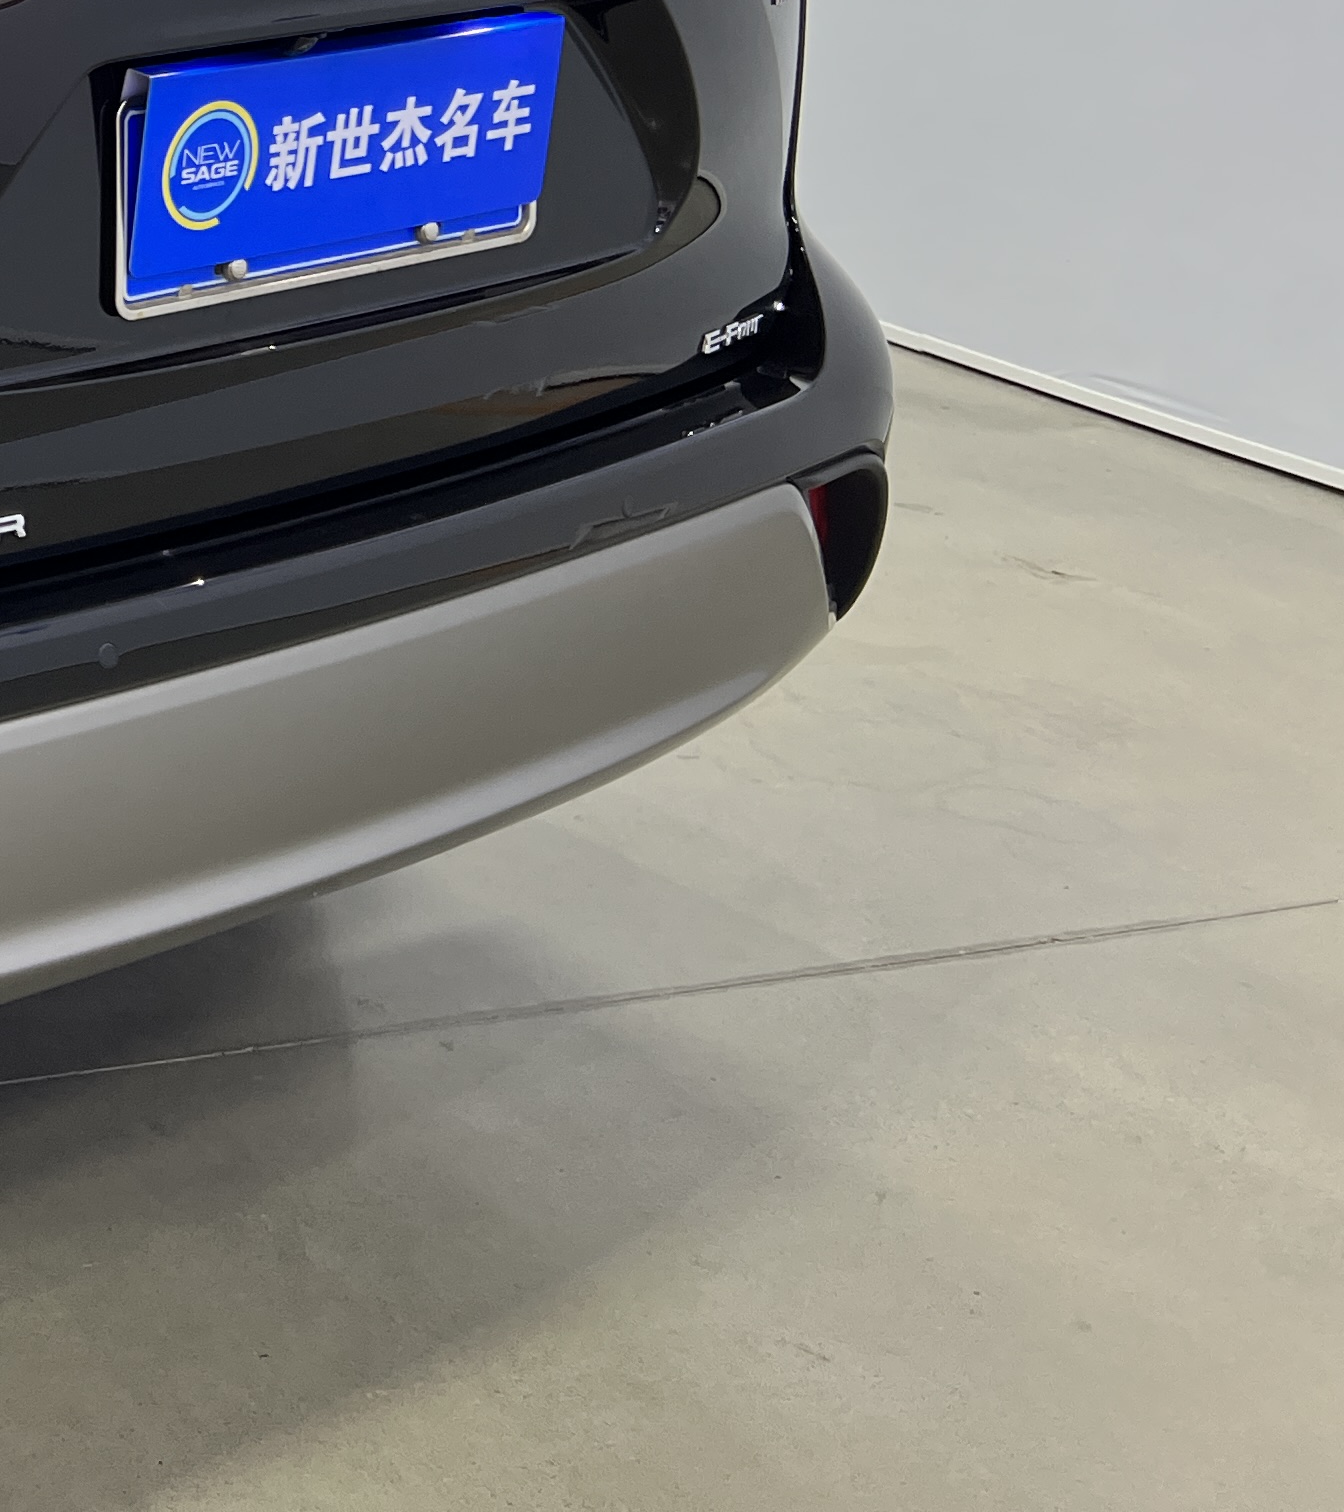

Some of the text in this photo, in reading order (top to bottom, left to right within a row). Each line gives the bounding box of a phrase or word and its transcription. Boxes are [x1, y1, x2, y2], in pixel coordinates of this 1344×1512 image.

[265, 79, 536, 192] 新世杰名车
[181, 139, 241, 169] NEW
[180, 160, 239, 185] SAGE
